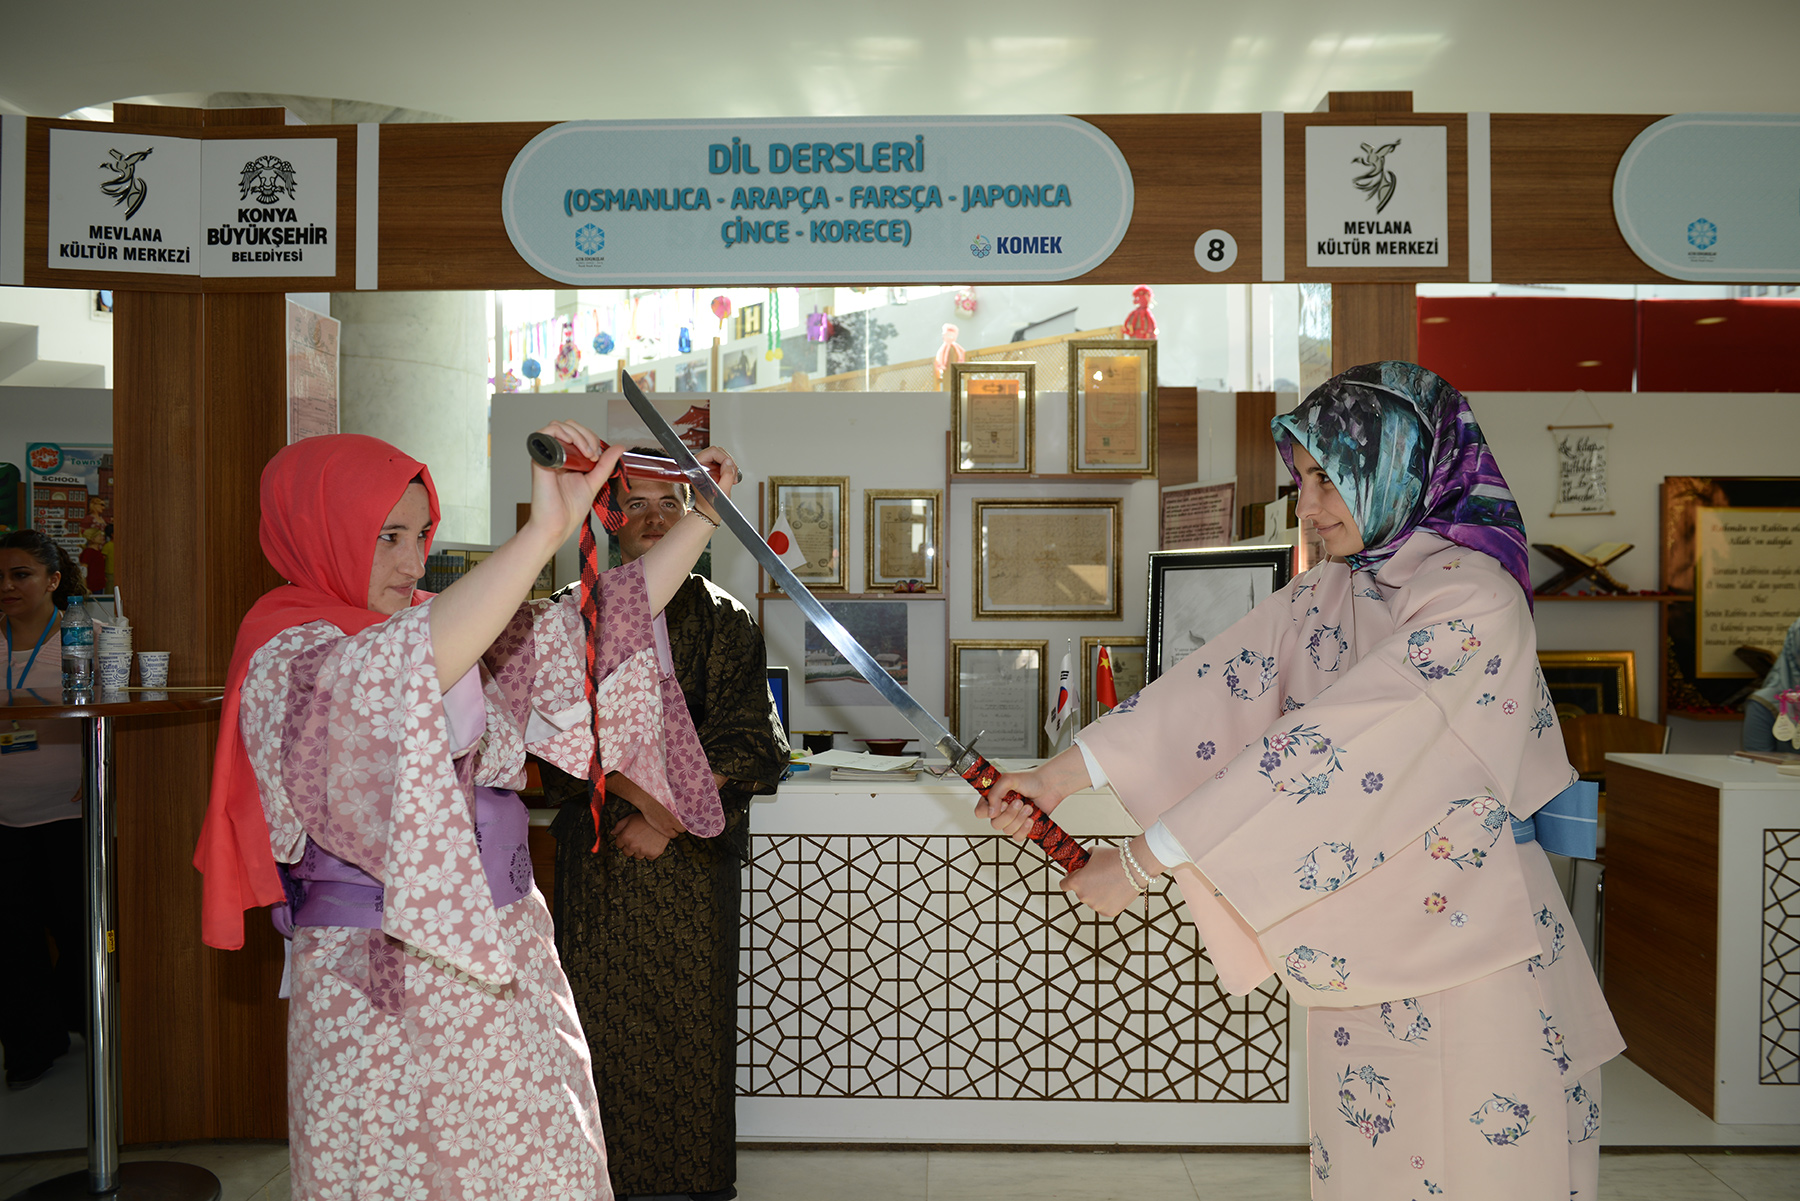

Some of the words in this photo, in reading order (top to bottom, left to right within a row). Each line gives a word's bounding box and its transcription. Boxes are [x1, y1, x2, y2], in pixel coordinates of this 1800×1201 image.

[709, 136, 761, 175] DİL
[769, 134, 924, 174] DERSLERİ
[564, 186, 711, 215] (OSMANLICA
[730, 185, 830, 214] ARAPÇA
[850, 184, 943, 213] FARSÇA
[961, 183, 1072, 213] JAPONCA
[238, 207, 297, 222] KONYA
[90, 225, 162, 242] MEVLANA
[208, 222, 327, 247] BÜYÜKŞEHİR
[721, 216, 789, 249] ÇİNCE
[810, 218, 912, 247] KORECE)
[1345, 221, 1412, 235] MEVLANA
[60, 241, 118, 259] KÜLTÜR
[124, 246, 190, 263] MERKEZİ
[998, 236, 1062, 254] KOMEK
[1207, 239, 1225, 261] 8
[1318, 238, 1371, 255] KÜLTÜR
[1376, 237, 1438, 255] MERKEZİ
[232, 248, 302, 262] BELEDİYESİ
[42, 475, 79, 483] SCHOOL
